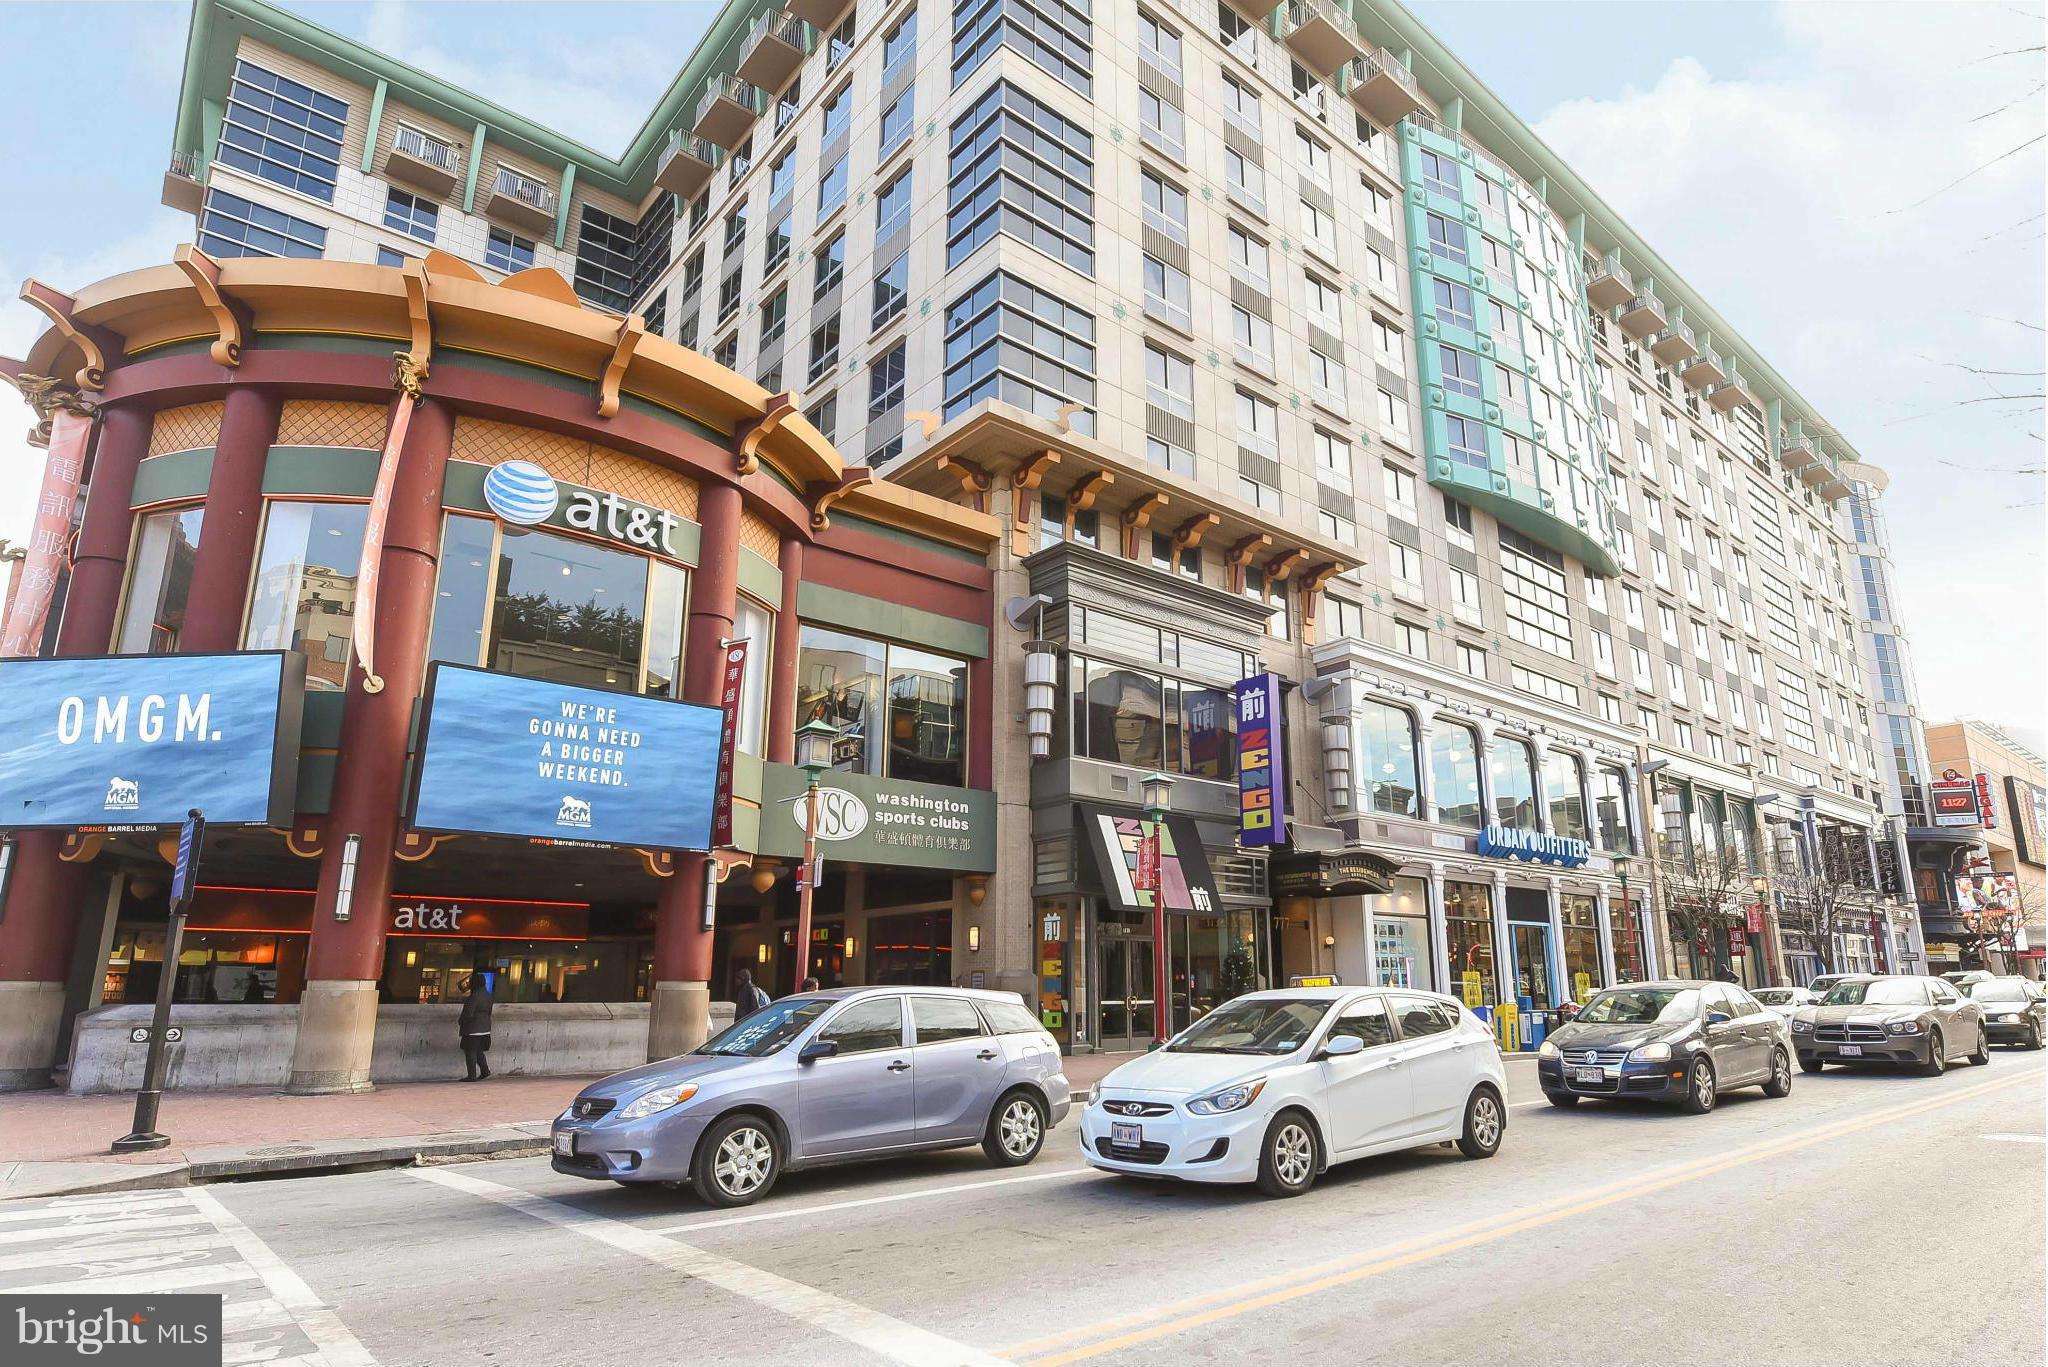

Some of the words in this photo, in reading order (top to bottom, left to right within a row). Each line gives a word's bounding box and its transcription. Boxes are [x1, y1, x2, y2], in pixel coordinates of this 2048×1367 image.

[565, 491, 679, 555] at&t
[561, 701, 617, 724] WE'RE
[1240, 687, 1265, 722] 前
[57, 693, 222, 745] OMGM.
[529, 718, 590, 741] GONNA
[598, 729, 641, 748] NEED
[540, 741, 552, 757] A
[561, 744, 624, 766] BIGGER
[538, 762, 629, 787] WEEKEND.
[1239, 728, 1271, 830] ZENGO
[105, 791, 139, 804] MGM
[875, 793, 969, 813] washington
[1975, 773, 1997, 829] REGAL
[557, 809, 591, 822] MGM
[874, 811, 925, 826] sports
[930, 815, 969, 831] clubs
[529, 837, 611, 849] orangebarrelmedia.com
[1487, 824, 1528, 850] URBAN
[1529, 831, 1592, 859] OUTFITTERS
[1190, 886, 1213, 912] 前
[394, 903, 463, 930] at&t
[1043, 912, 1061, 941] 前
